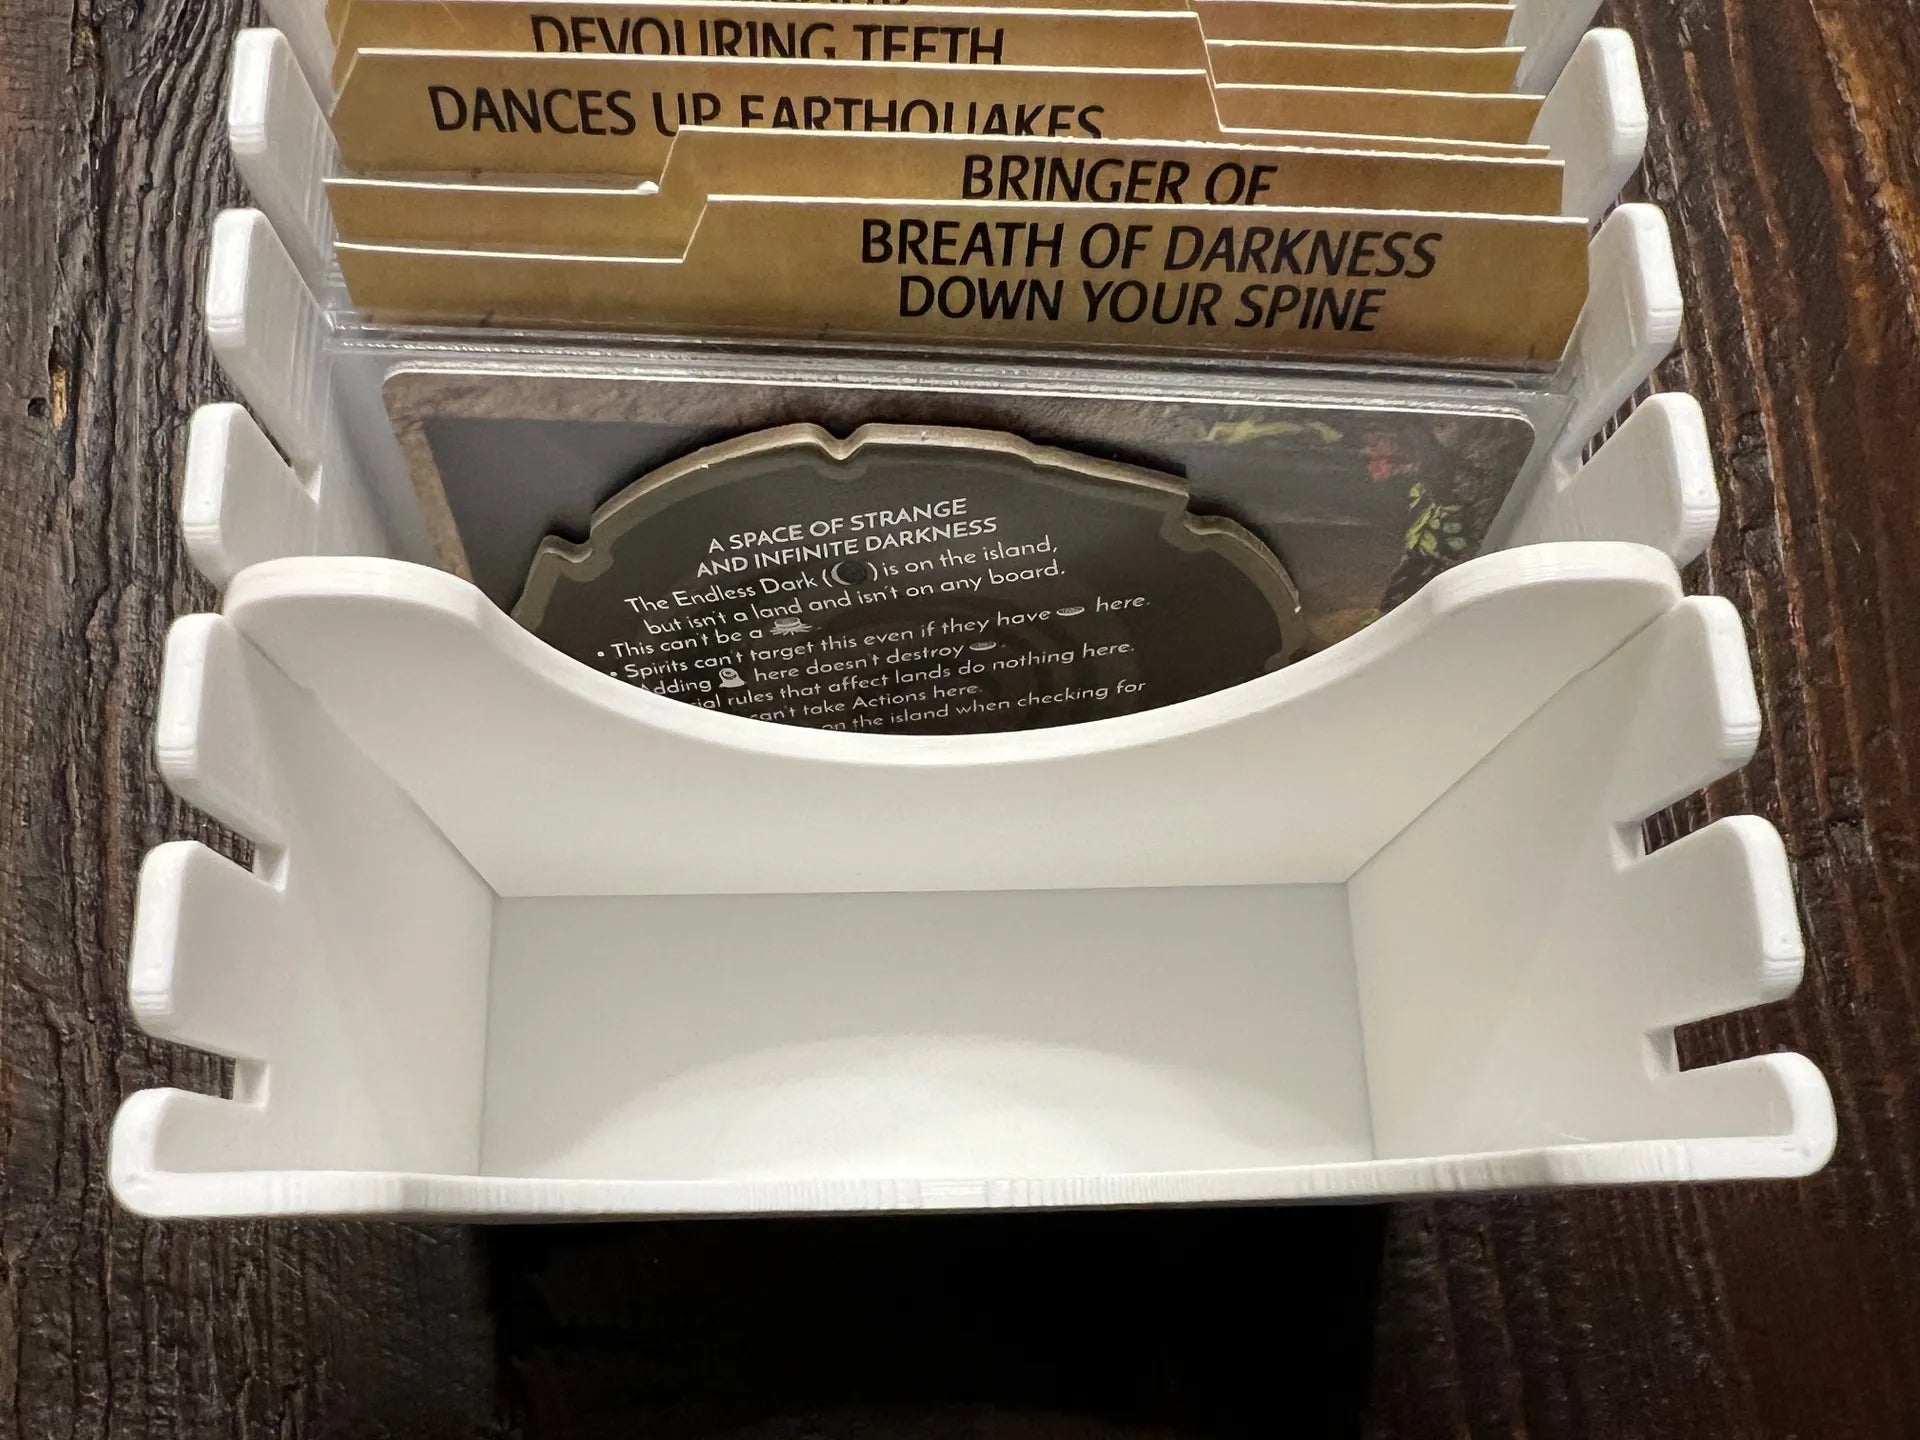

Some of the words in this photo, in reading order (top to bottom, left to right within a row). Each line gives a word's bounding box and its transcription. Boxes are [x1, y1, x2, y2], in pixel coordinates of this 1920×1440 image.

[531, 14, 836, 59] DEVOURING
[853, 24, 1004, 65] TEETH
[428, 85, 637, 136] DANCES
[652, 91, 721, 137] UP
[740, 94, 1105, 139] EARTHQUAKES
[962, 154, 1190, 203] BRINGER
[1205, 162, 1278, 205] OF
[862, 218, 1064, 267] BREATH
[1080, 222, 1153, 269] OF
[1164, 225, 1443, 279] DARKNESS
[900, 275, 1064, 321] DOWN
[1083, 279, 1222, 326] YOUR
[1234, 284, 1387, 331] SPINE
[697, 556, 748, 578] AND
[754, 538, 859, 569] INFINITE
[865, 516, 998, 552] DARKNESS
[708, 538, 725, 554] A
[729, 523, 804, 550] SPACE
[809, 517, 844, 537] OF
[850, 497, 967, 532] STRANGE
[624, 596, 670, 613] The
[672, 584, 756, 607] Endless
[759, 570, 818, 594] Dark
[882, 562, 899, 577] is
[904, 559, 934, 574] on
[939, 548, 977, 568] the
[982, 534, 1058, 561] island,
[643, 619, 682, 636] but
[687, 611, 727, 630] isn't
[733, 611, 749, 622] a
[751, 597, 803, 620] land
[808, 590, 852, 612] and
[856, 585, 899, 605] isn't
[905, 583, 934, 598] on
[940, 576, 982, 592] any
[988, 558, 1065, 585] board.
[610, 642, 655, 659] This
[660, 632, 709, 651] can't
[715, 629, 742, 645] be
[749, 628, 763, 640] a
[624, 660, 689, 680] Spirits
[694, 650, 744, 669] can't
[750, 641, 815, 662] target
[820, 635, 858, 651] this
[863, 629, 913, 647] even
[921, 621, 936, 638] if
[941, 617, 990, 636] they
[997, 610, 1051, 627] have
[753, 667, 799, 682] here
[805, 652, 880, 676] doesn't
[886, 644, 965, 665] destroy
[727, 690, 774, 706] rules
[779, 684, 822, 699] that
[828, 673, 890, 694] affect
[895, 663, 951, 684] lands
[958, 660, 986, 675] do
[993, 650, 1075, 671] nothing
[1082, 642, 1135, 659] here.
[803, 700, 845, 716] take
[852, 690, 927, 710] Actions
[853, 714, 884, 729] the
[890, 703, 949, 724] island
[955, 700, 1011, 715] when
[1017, 687, 1109, 708] checking
[1116, 679, 1147, 695] for
